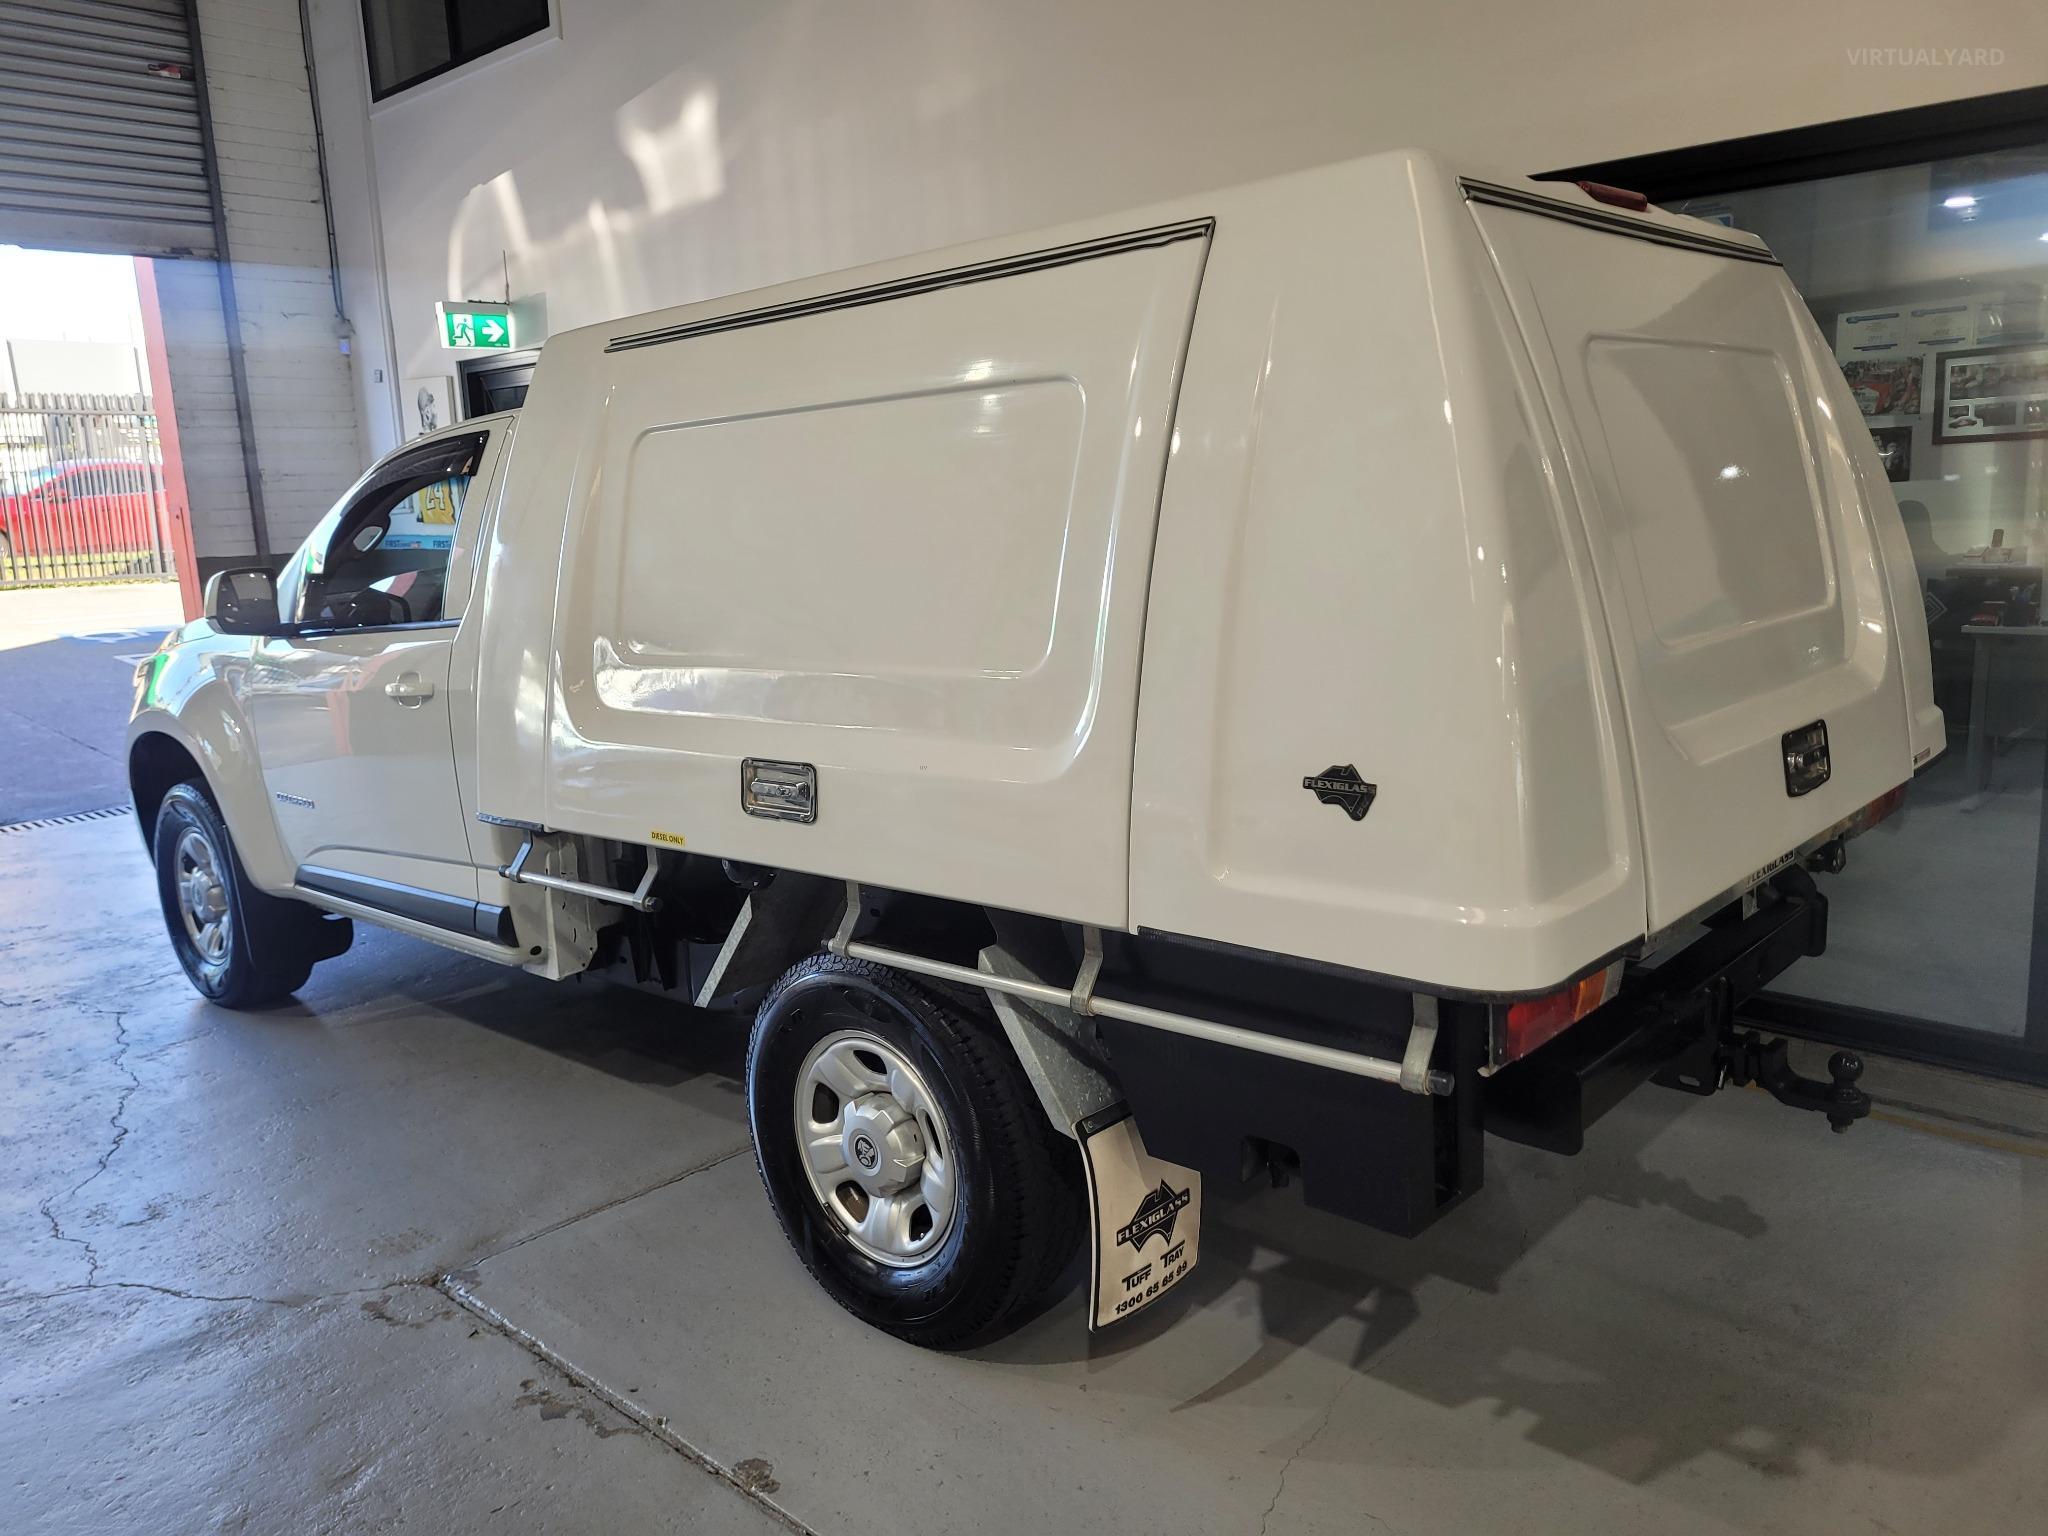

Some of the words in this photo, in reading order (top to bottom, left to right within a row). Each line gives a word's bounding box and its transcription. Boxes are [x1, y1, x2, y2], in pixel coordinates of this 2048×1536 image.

[651, 832, 669, 842] DIESEL
[669, 835, 684, 845] ONLY
[1118, 1193, 1189, 1243] FLEXIGLASS
[1115, 1292, 1143, 1315] 1300
[1146, 1281, 1160, 1298] 65
[1162, 1273, 1174, 1287] 65
[1176, 1261, 1188, 1276] 99
